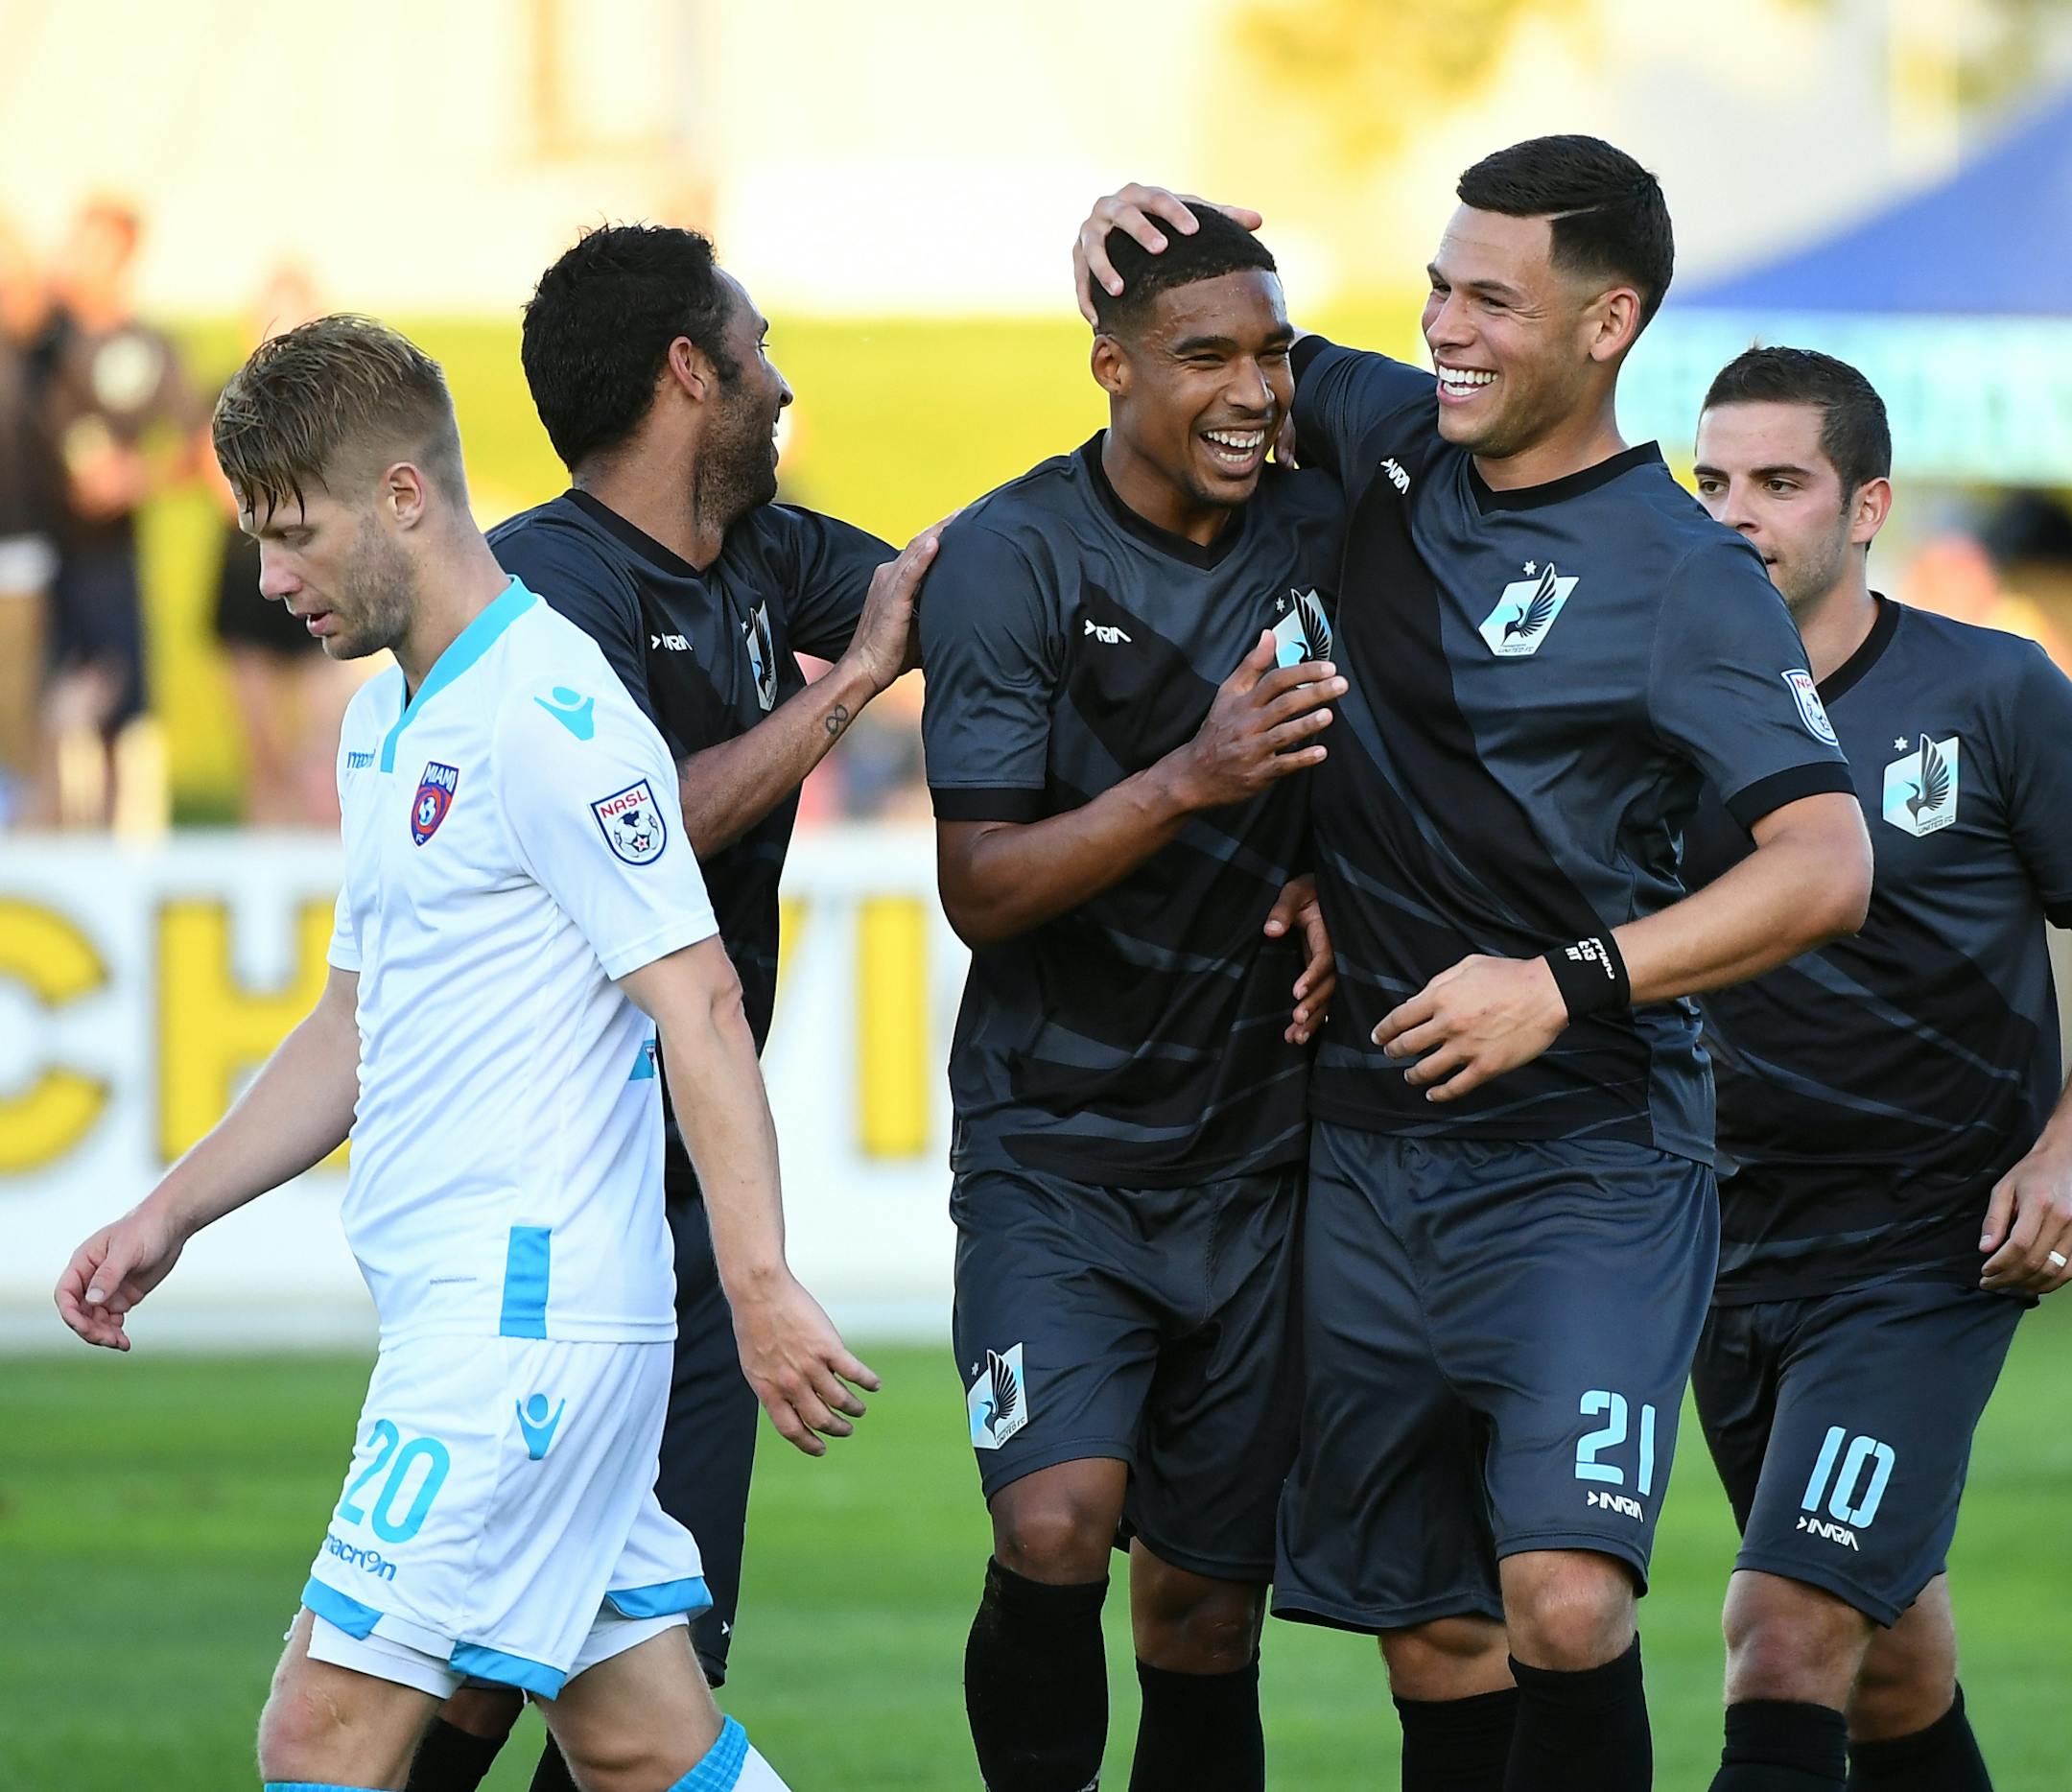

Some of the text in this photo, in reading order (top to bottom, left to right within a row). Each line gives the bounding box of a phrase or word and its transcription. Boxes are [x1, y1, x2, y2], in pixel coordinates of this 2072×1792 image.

[422, 764, 458, 794] MIAMI
[600, 790, 648, 819] NASL
[337, 1419, 451, 1544] 20
[1575, 1389, 1657, 1497] 21
[1801, 1426, 1895, 1529] 10
